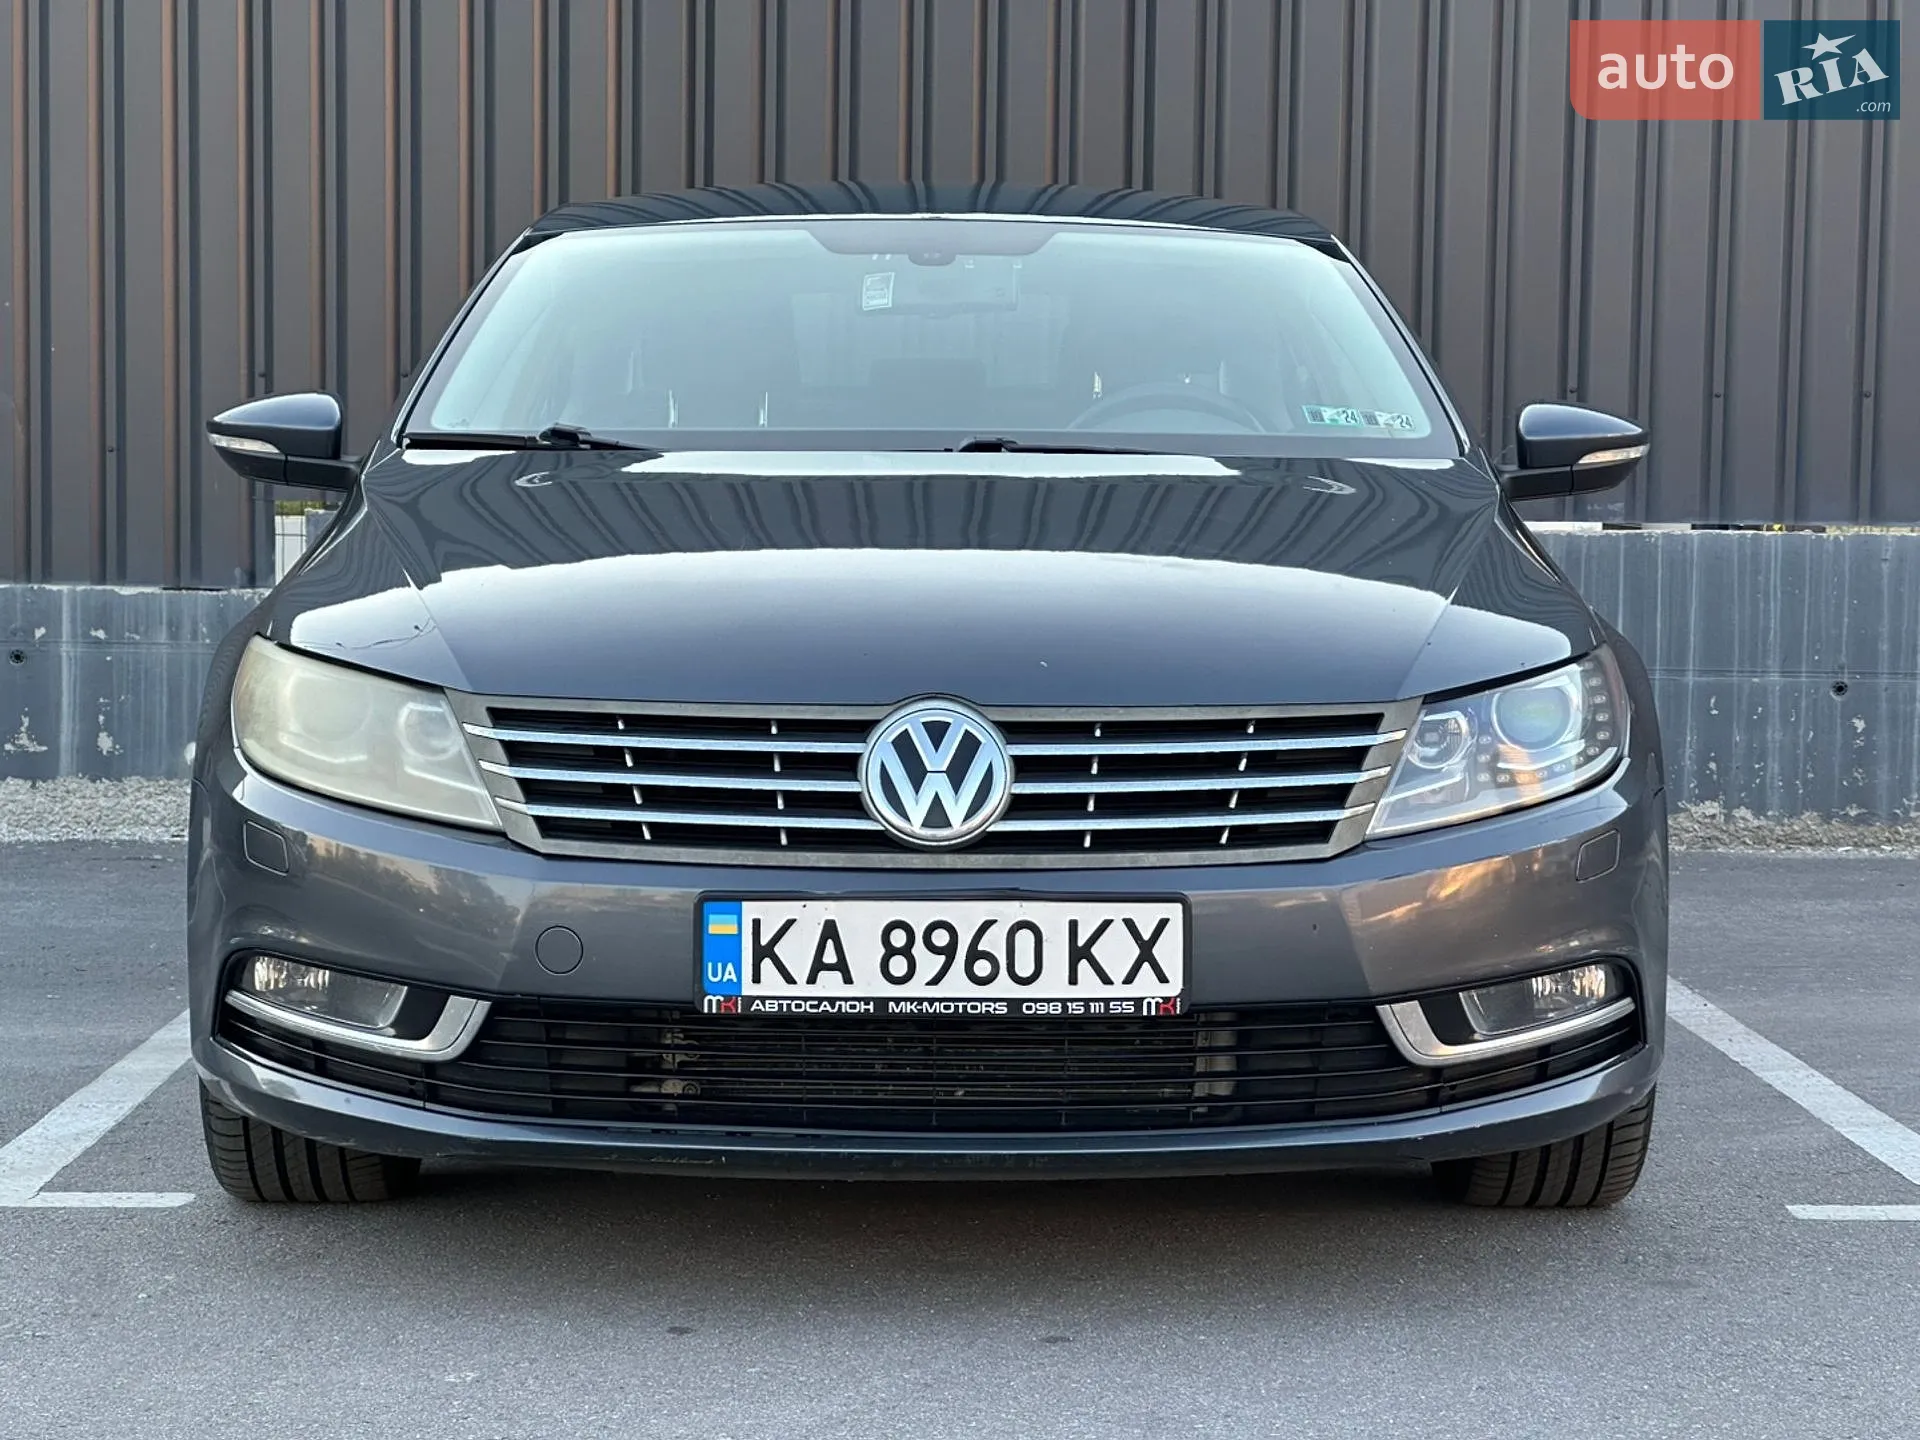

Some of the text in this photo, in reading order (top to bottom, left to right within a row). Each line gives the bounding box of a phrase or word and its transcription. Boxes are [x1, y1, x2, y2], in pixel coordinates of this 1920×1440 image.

[751, 918, 1171, 987] KA 8960 KX
[708, 962, 737, 984] UA
[750, 999, 875, 1014] АВТОСАЛОН
[888, 1000, 1008, 1015] MK-MOTORS
[1022, 1002, 1063, 1015] 098
[1066, 1002, 1084, 1015] 15
[1108, 1001, 1135, 1015] 55
